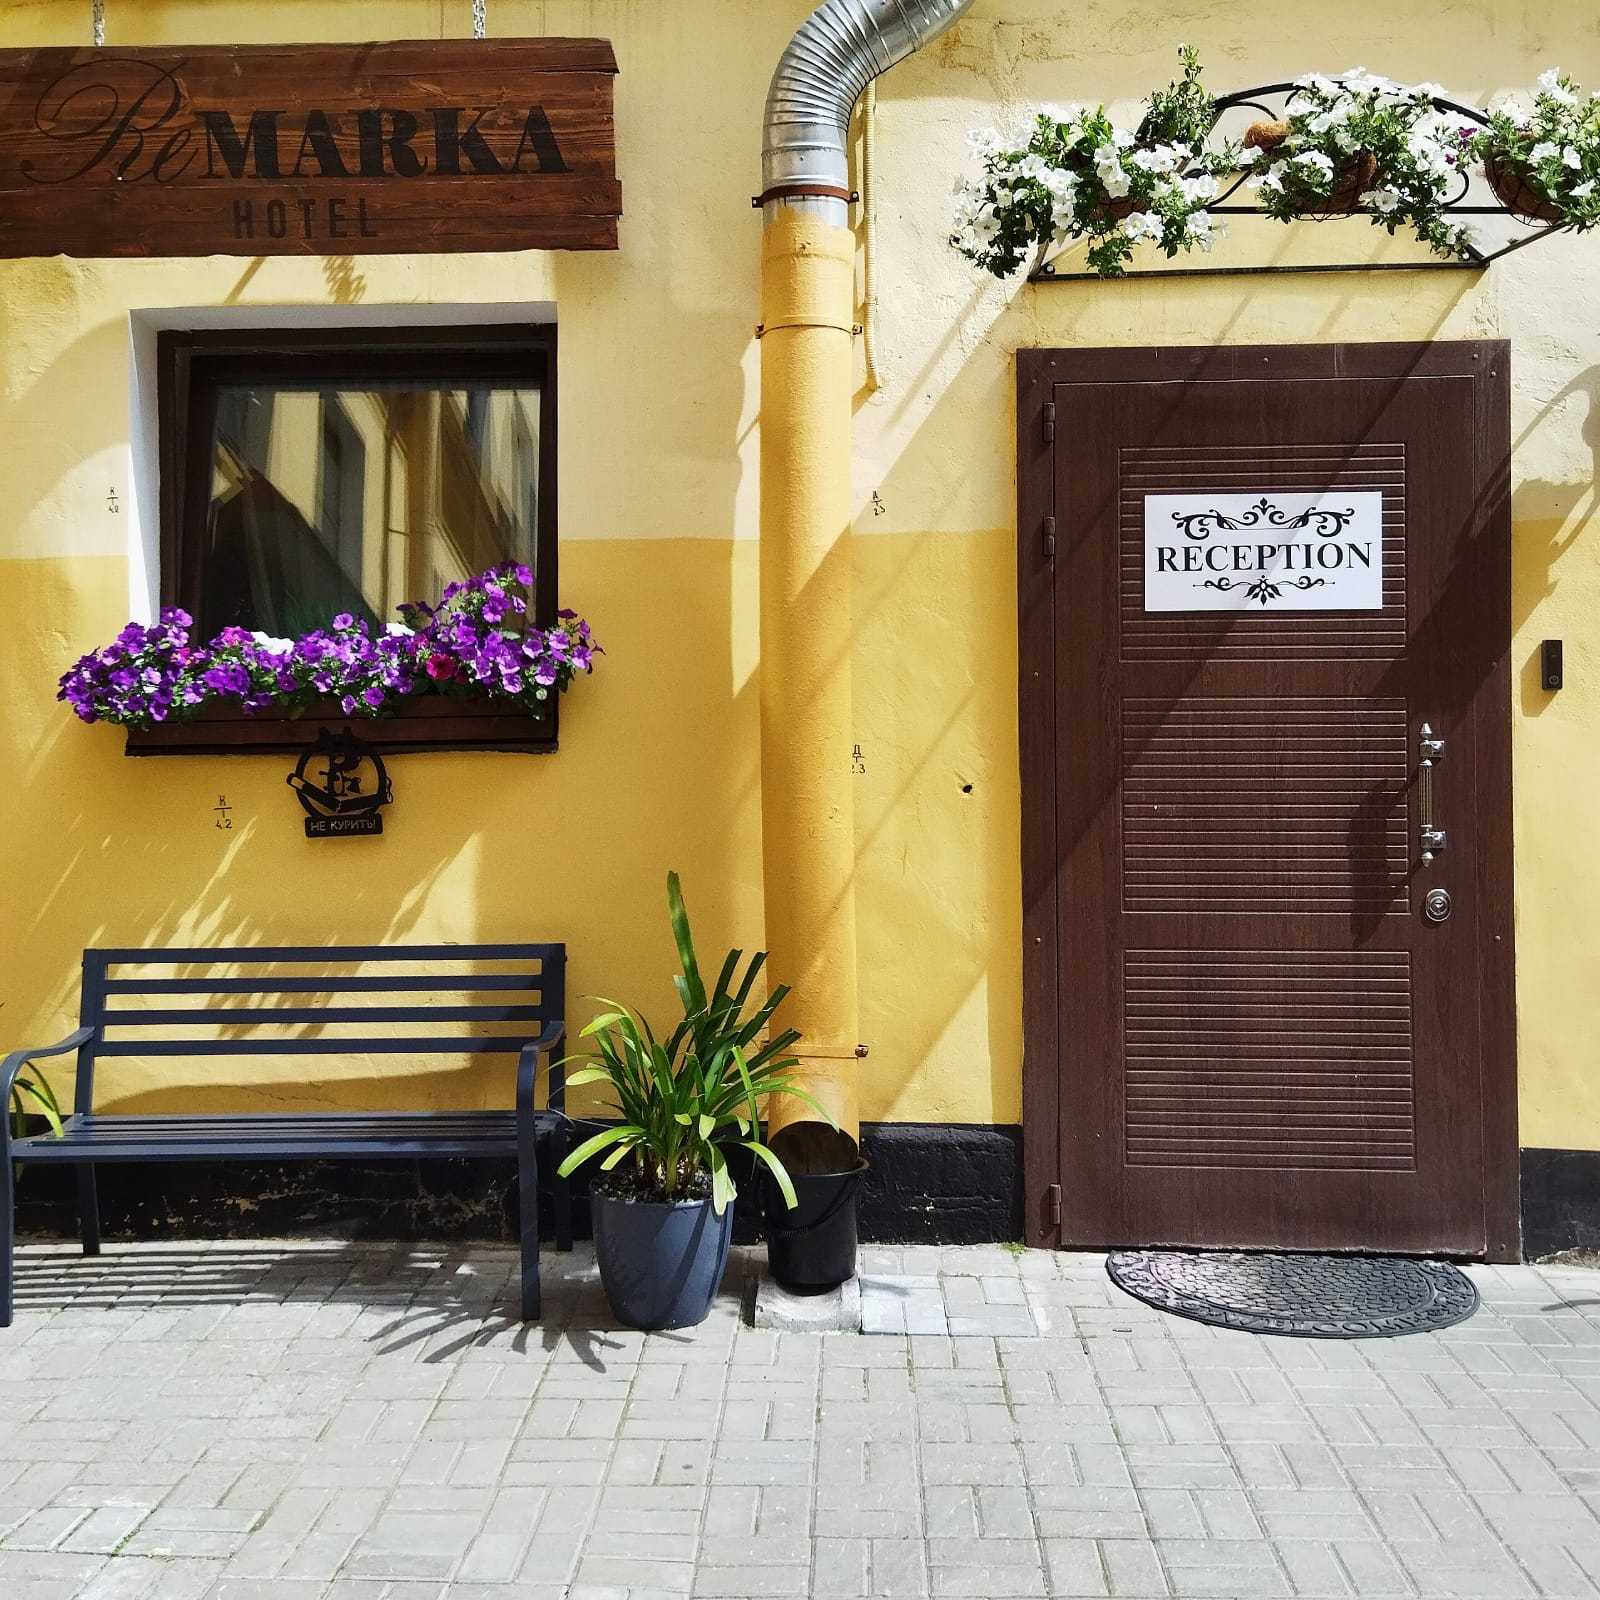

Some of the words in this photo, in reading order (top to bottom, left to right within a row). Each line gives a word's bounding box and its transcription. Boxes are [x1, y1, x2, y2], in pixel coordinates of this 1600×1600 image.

[232, 197, 378, 240] HOTEL
[1155, 542, 1373, 573] RECEPTION
[310, 820, 327, 832] НЕ
